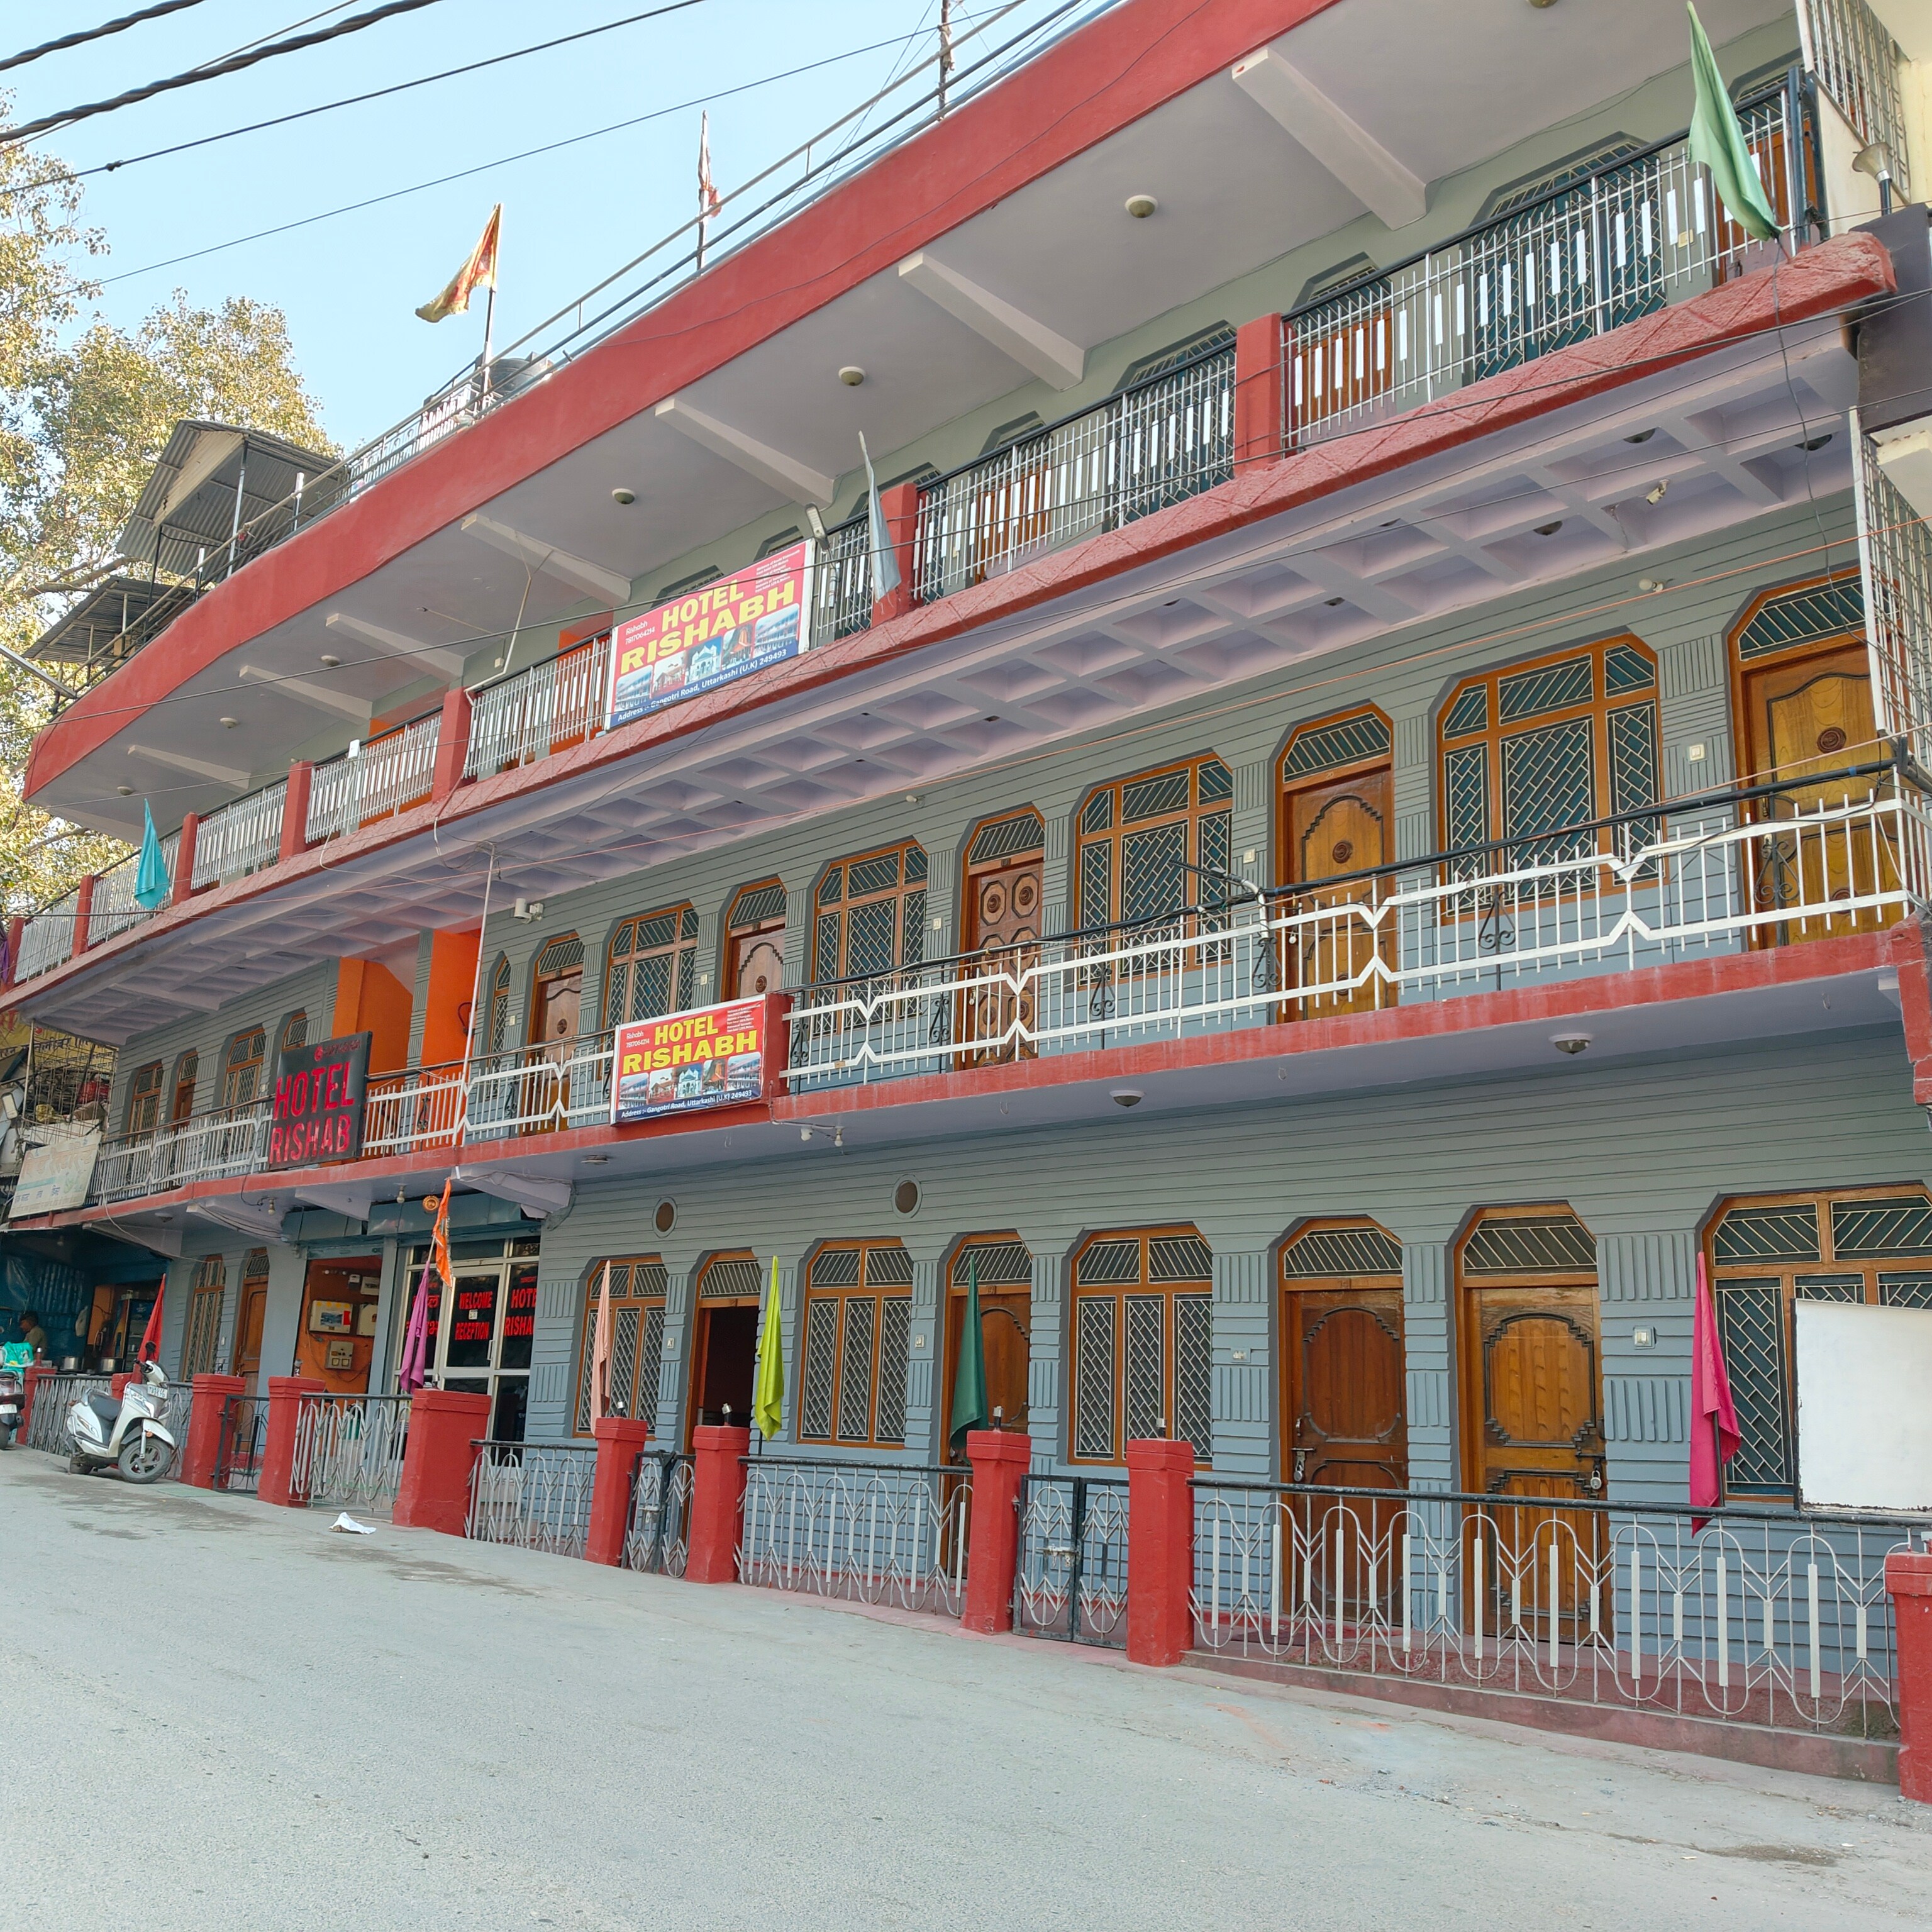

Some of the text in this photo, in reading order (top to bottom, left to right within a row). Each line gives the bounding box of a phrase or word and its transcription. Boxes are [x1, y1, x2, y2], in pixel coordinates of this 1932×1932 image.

[662, 579, 744, 633] HOTEL
[620, 580, 795, 675] RISHABH
[626, 620, 648, 636] Rishabh
[618, 706, 643, 722] Address
[650, 691, 679, 708] Gangotri
[680, 683, 700, 697] Road,
[701, 669, 738, 688] Uttarkashi
[740, 660, 758, 675] (U.K)
[759, 648, 787, 666] 249493
[654, 1015, 718, 1046] HOTEL
[623, 1030, 757, 1075] RISHABH
[273, 1062, 355, 1121] HOTEL
[621, 1109, 641, 1118] Address
[647, 1103, 670, 1113] Gangotri
[670, 1101, 686, 1109] Road,
[687, 1095, 716, 1106] Uttarkashi
[731, 1089, 752, 1099] 249493
[270, 1114, 351, 1163] RISHAB
[459, 1291, 493, 1309] WELCOME
[511, 1287, 538, 1309] HOTE
[455, 1321, 490, 1340] RECEPTION
[504, 1316, 534, 1336] RISHA
